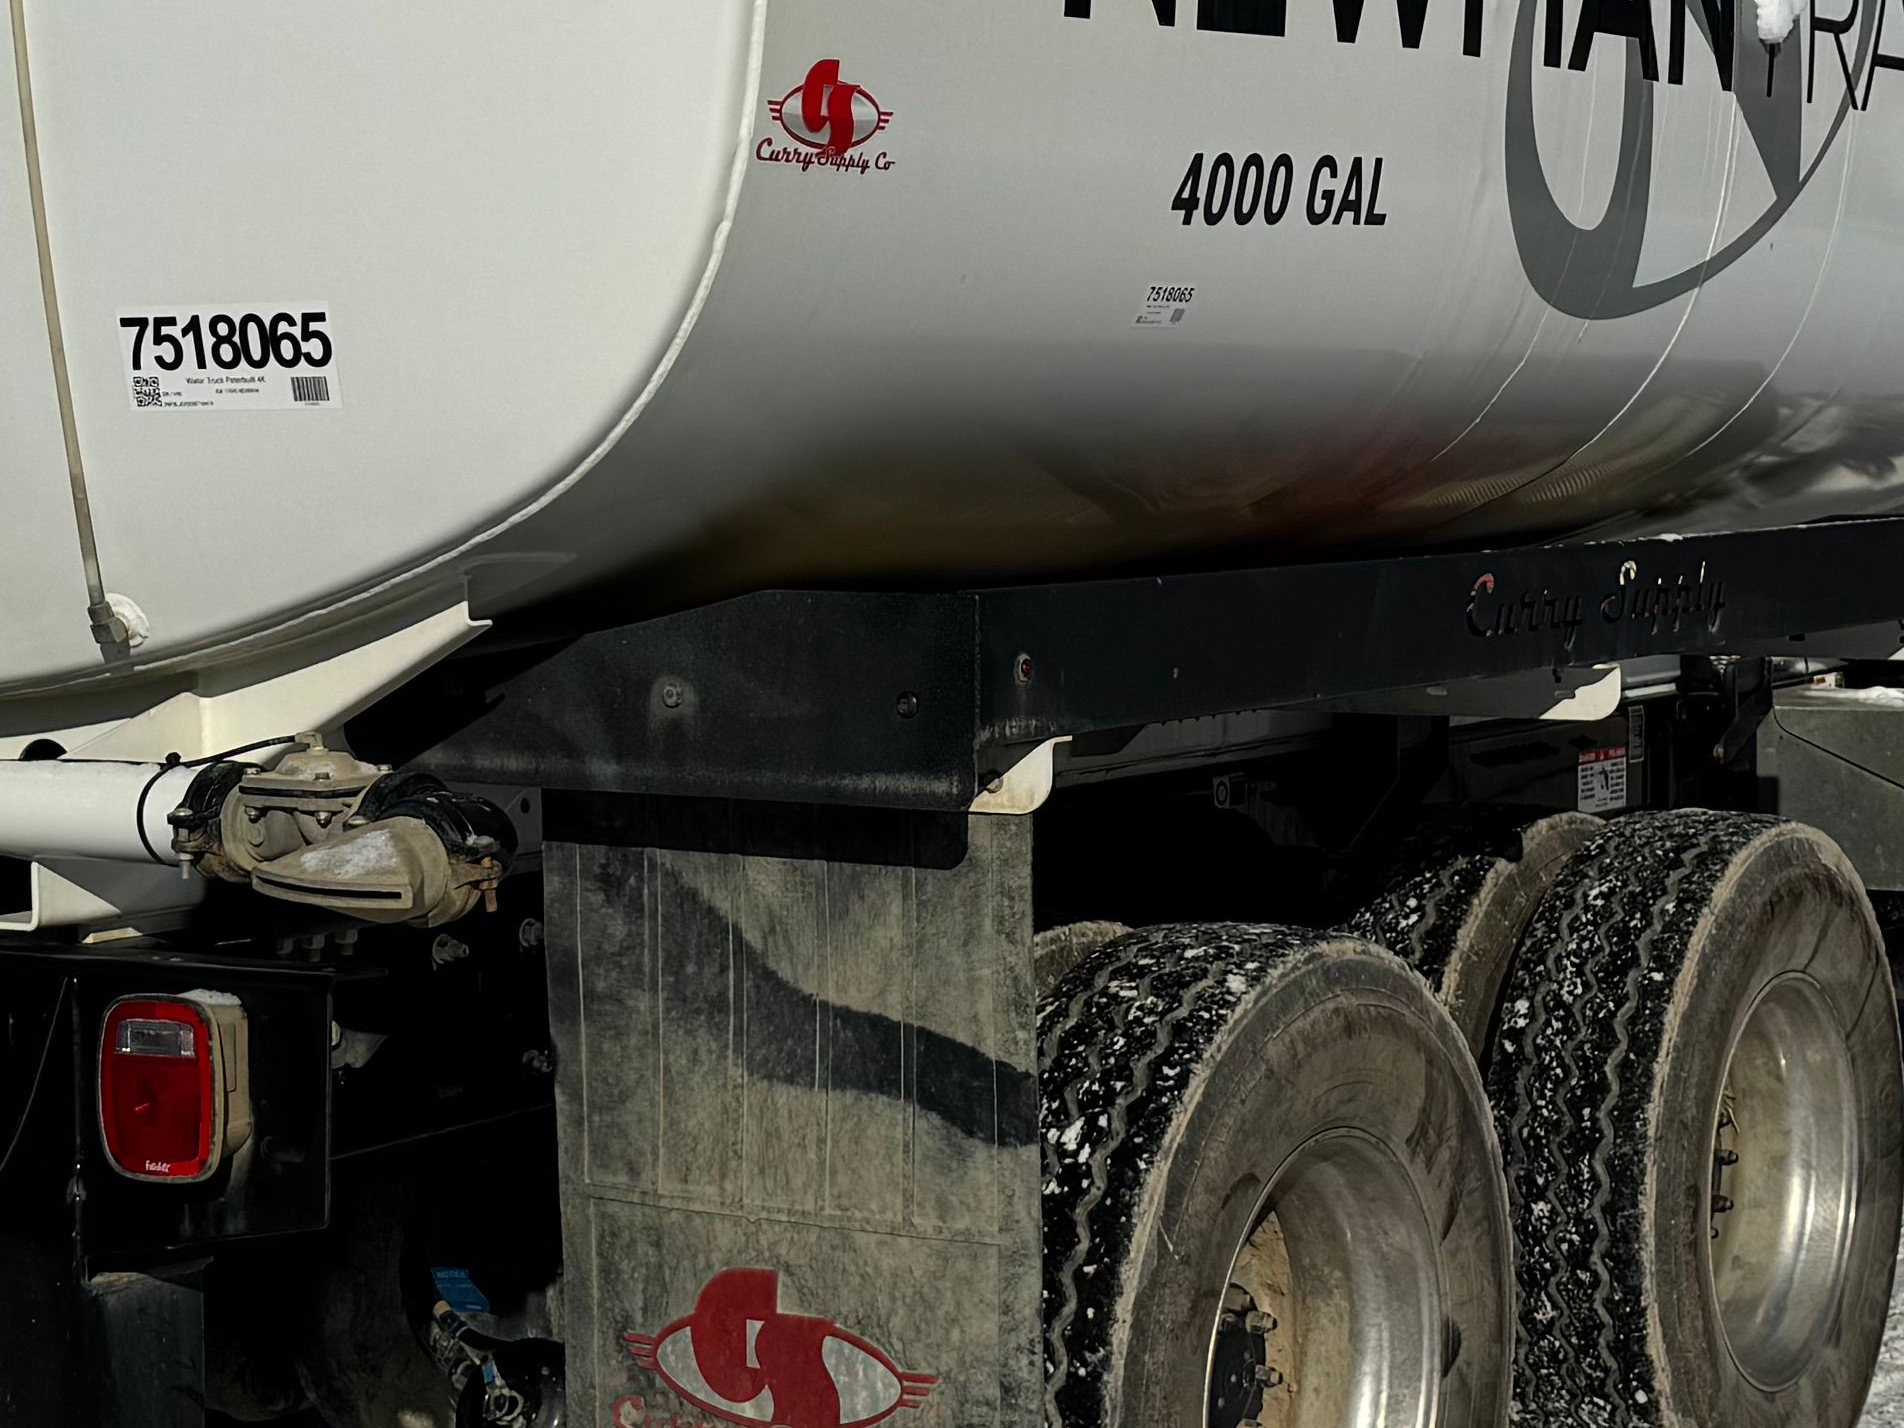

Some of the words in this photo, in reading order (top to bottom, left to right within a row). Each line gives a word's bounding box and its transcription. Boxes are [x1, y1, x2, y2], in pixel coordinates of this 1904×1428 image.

[756, 137, 815, 172] Curry
[816, 146, 870, 175] Supply
[875, 152, 895, 171] Co
[1171, 152, 1294, 226] 4000
[1305, 156, 1387, 226] GAL
[1146, 286, 1195, 303] 7518065
[119, 312, 332, 371] 7518065
